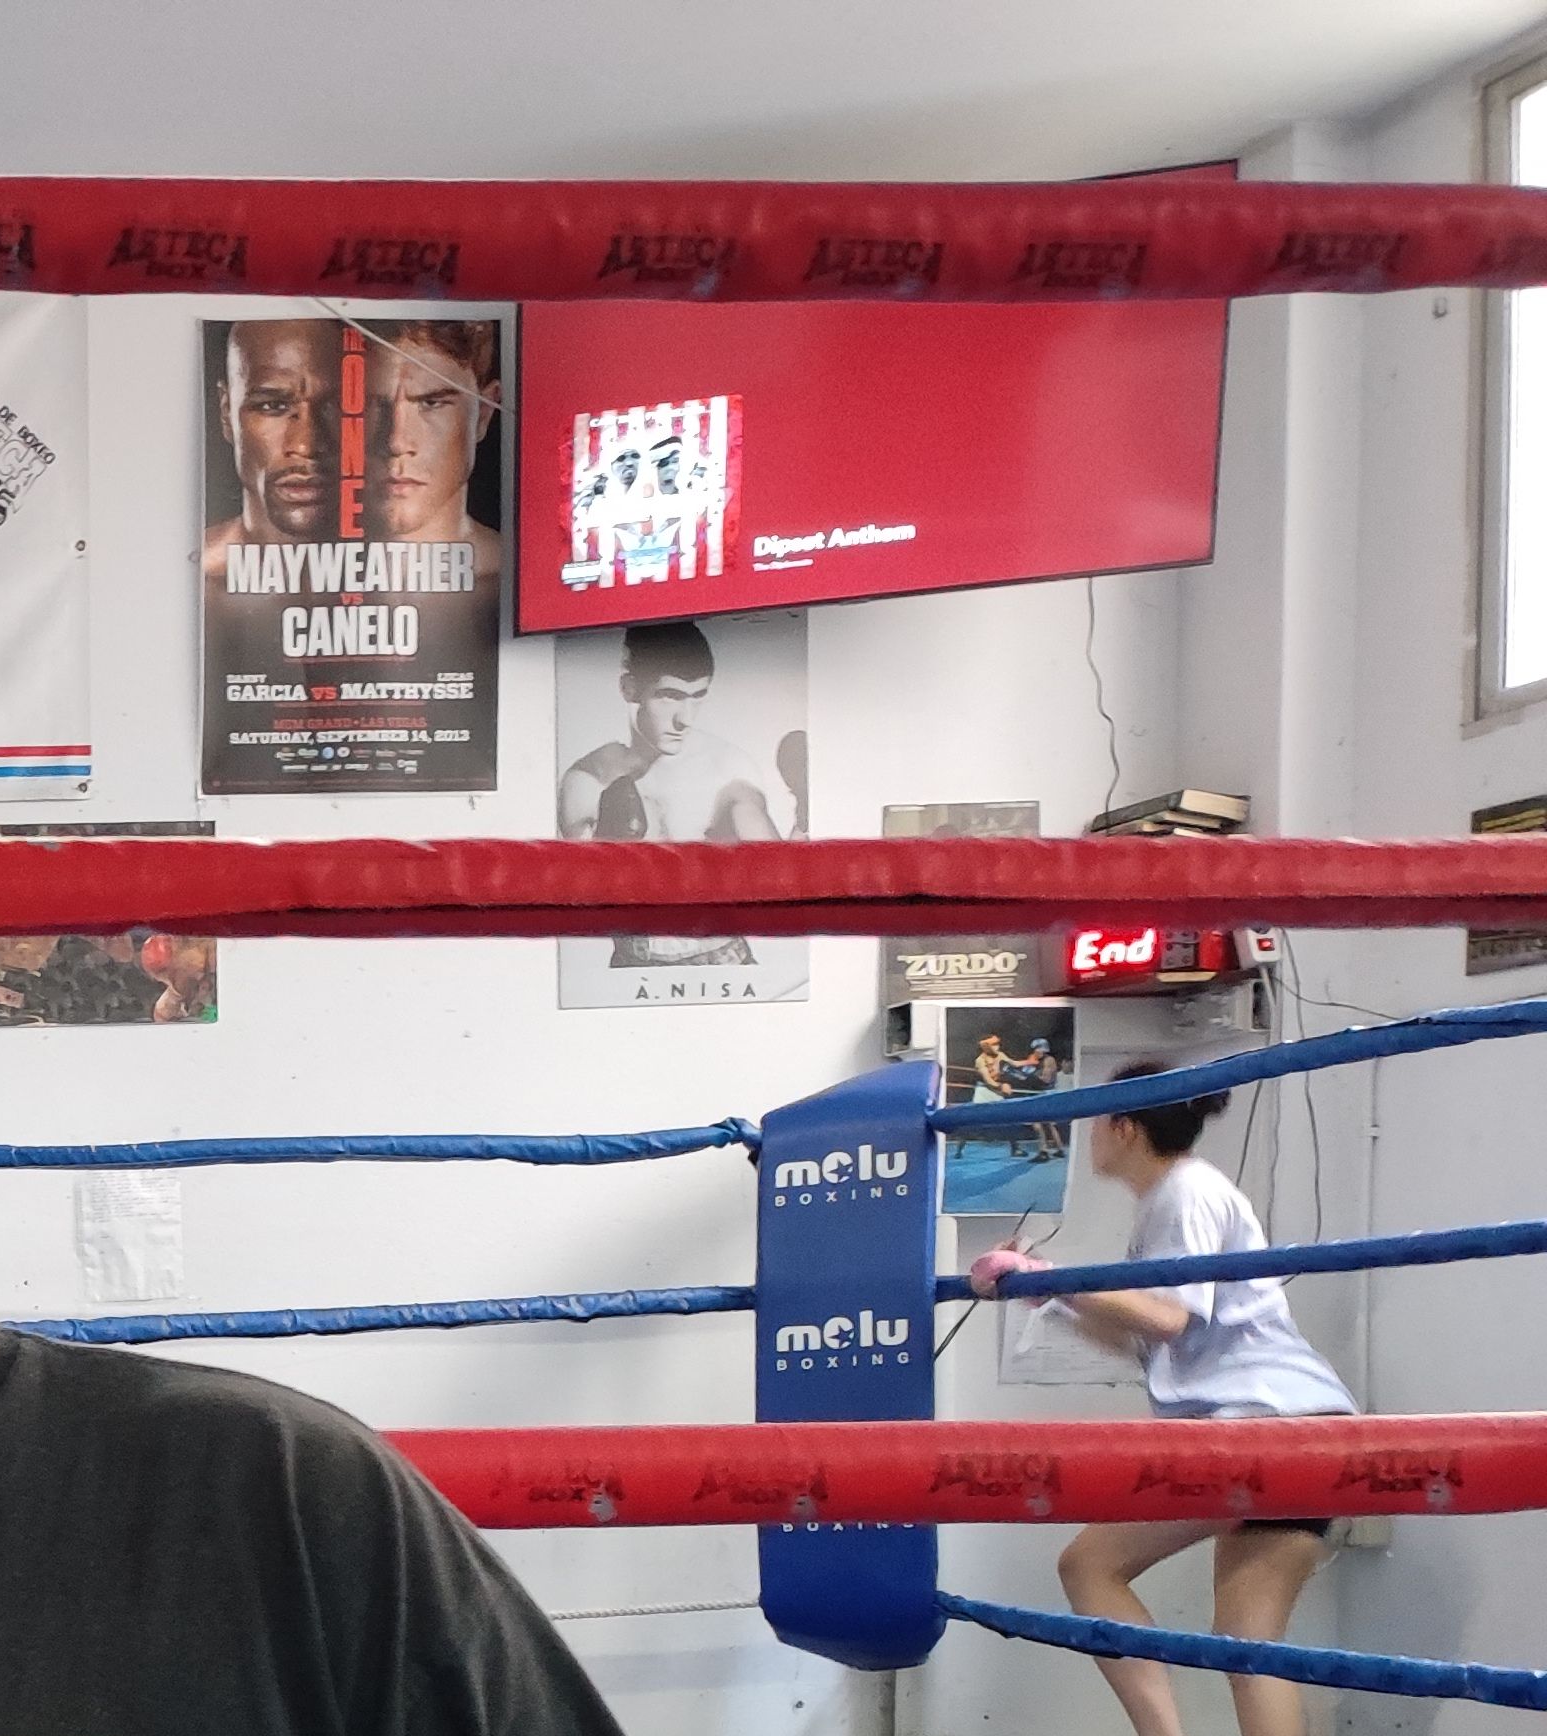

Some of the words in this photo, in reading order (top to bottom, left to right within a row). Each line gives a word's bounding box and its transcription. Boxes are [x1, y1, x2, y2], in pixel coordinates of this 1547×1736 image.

[225, 542, 475, 595] MAYWEATHER
[281, 605, 420, 659] CANELO
[226, 684, 308, 702] GARCIA
[340, 682, 475, 701] MATTHYSSE
[901, 950, 1023, 977] ZURDO
[1071, 926, 1157, 971] End
[774, 1144, 907, 1188] molu
[774, 1184, 908, 1207] BOXING
[775, 1310, 909, 1352] molu
[776, 1352, 909, 1371] BOXING
